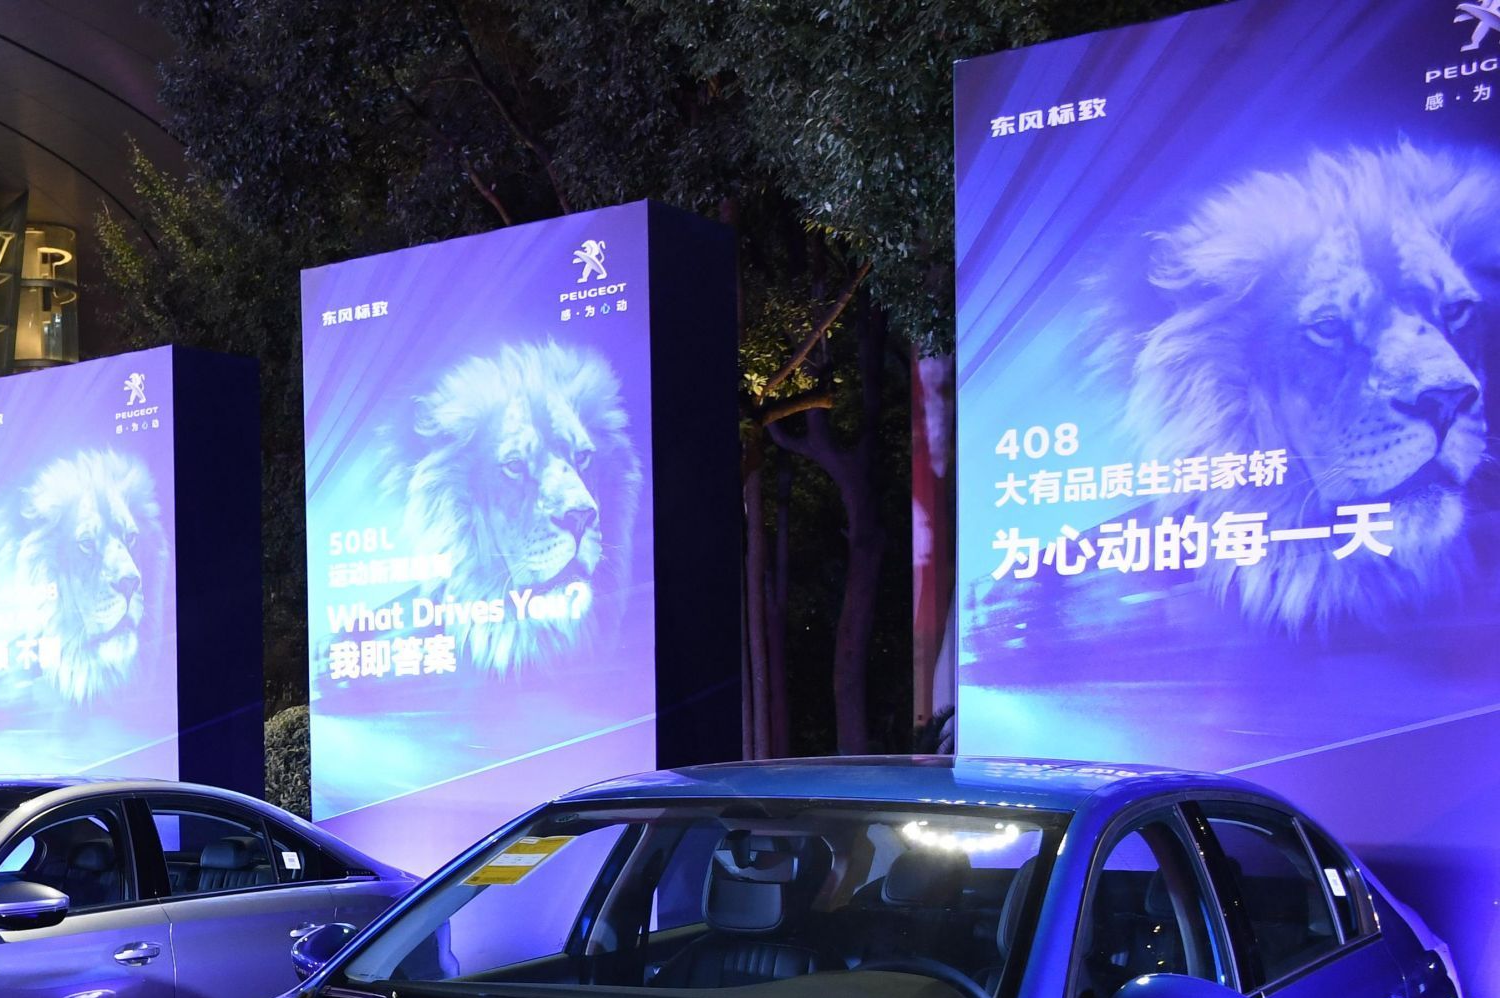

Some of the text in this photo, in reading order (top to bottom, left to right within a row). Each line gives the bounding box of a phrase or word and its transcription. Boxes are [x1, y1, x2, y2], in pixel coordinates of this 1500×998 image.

[990, 98, 1107, 138] 东风标致
[560, 283, 627, 302] PEUGEOT
[322, 301, 389, 327] 东风标致
[115, 406, 159, 420] PEUGEOT
[995, 422, 1079, 461] 408
[994, 448, 1288, 508] 大有品质生活家轿
[990, 502, 1394, 581] 为心动的每一天
[327, 601, 405, 634] What
[412, 594, 505, 629] Drives
[329, 634, 457, 680] 我即答案
